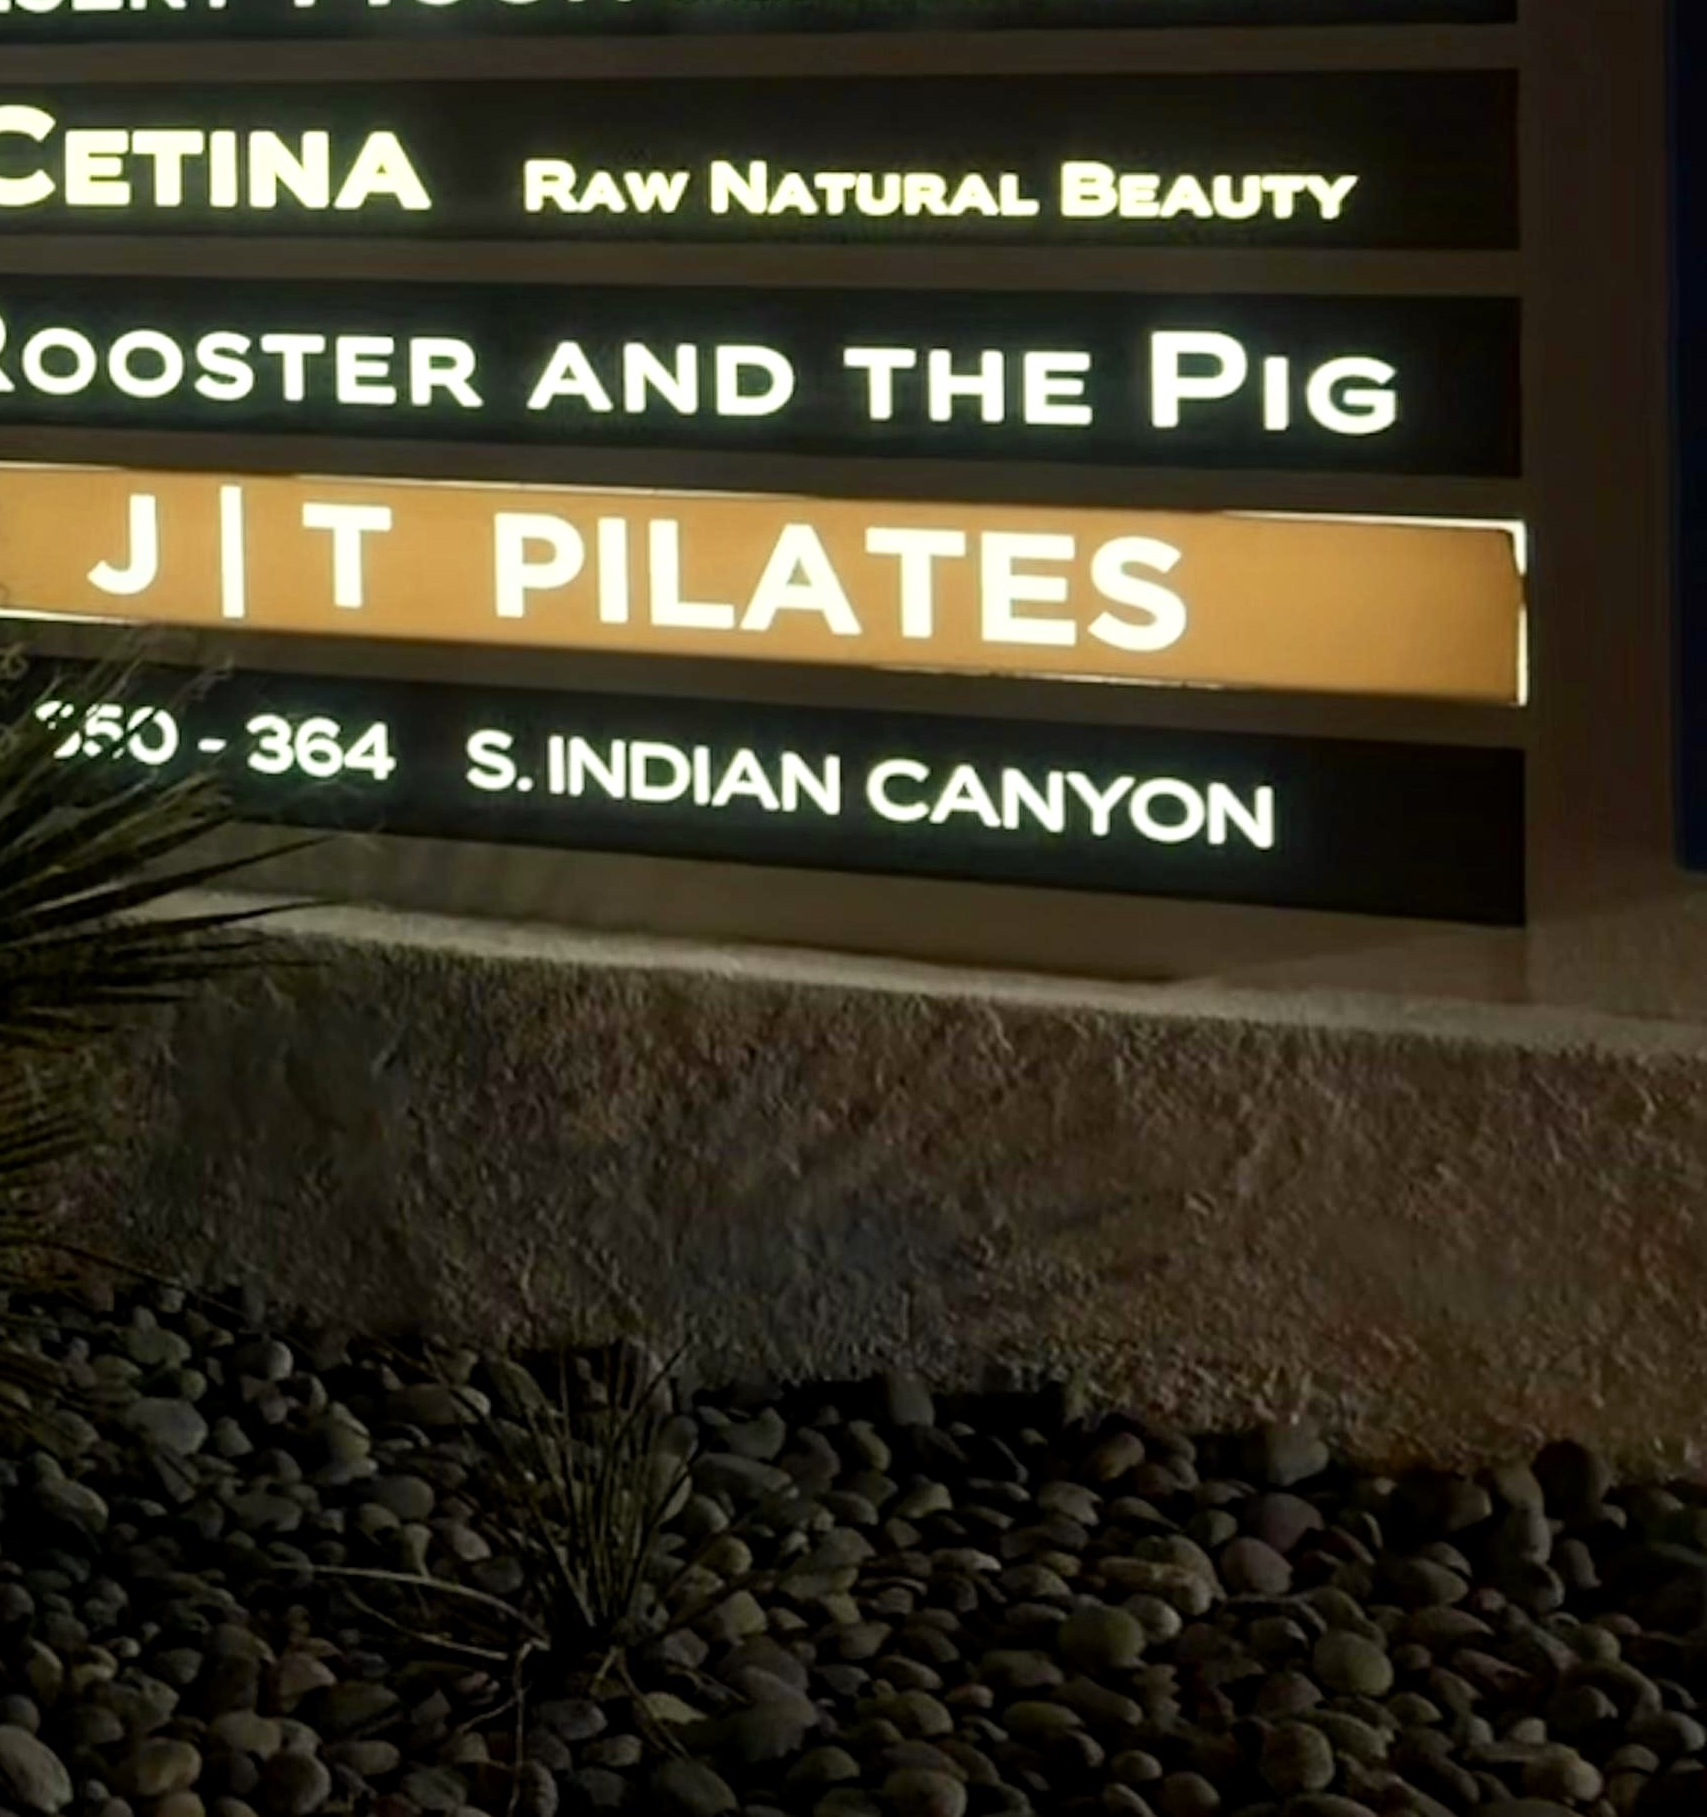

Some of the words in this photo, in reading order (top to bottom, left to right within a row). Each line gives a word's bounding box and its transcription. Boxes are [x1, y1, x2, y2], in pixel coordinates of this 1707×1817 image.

[523, 159, 690, 214] RAW
[710, 160, 1040, 218] NATURAL
[1060, 161, 1358, 221] BEAUTY
[527, 340, 796, 418] AND
[843, 345, 1092, 427] THE
[1150, 329, 1399, 435] PIG
[493, 510, 1188, 652] PILATES
[245, 713, 397, 781] 364
[866, 758, 1274, 849] CANYON
